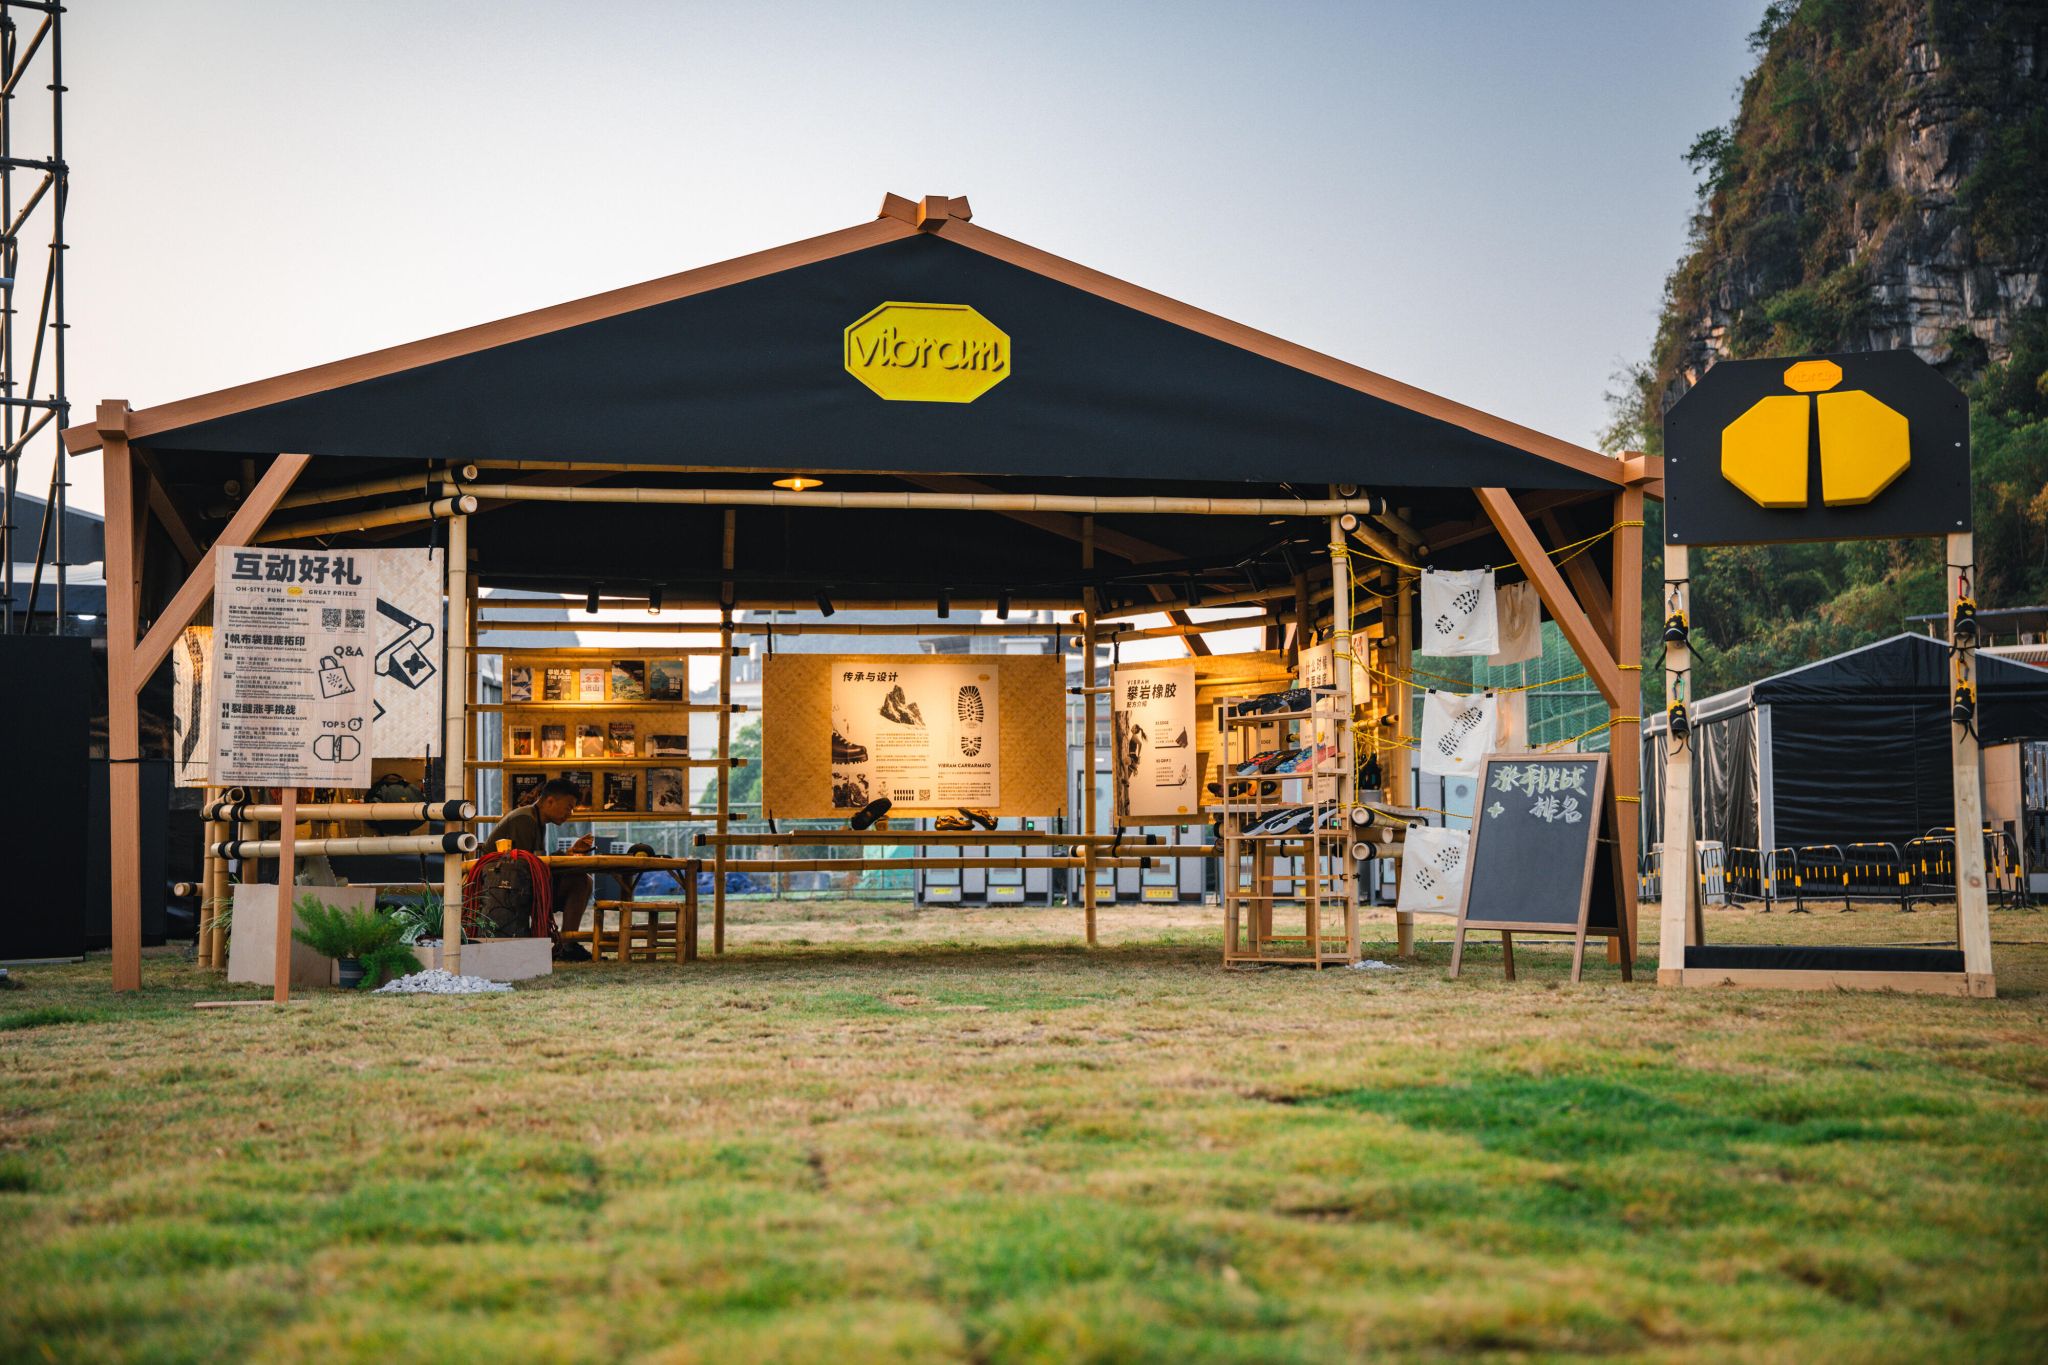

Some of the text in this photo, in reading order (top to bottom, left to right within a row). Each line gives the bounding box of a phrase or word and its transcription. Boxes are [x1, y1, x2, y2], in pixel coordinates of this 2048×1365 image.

[232, 553, 362, 585] 互动好礼
[229, 633, 305, 646] 帆布袋鞋底拓印
[334, 646, 364, 659] Q&A
[843, 672, 898, 682] 传承与设计
[1127, 683, 1176, 700] 攀岩橡胶
[231, 703, 296, 715] 裂缝涨手挑战
[1529, 795, 1582, 823] 排名
